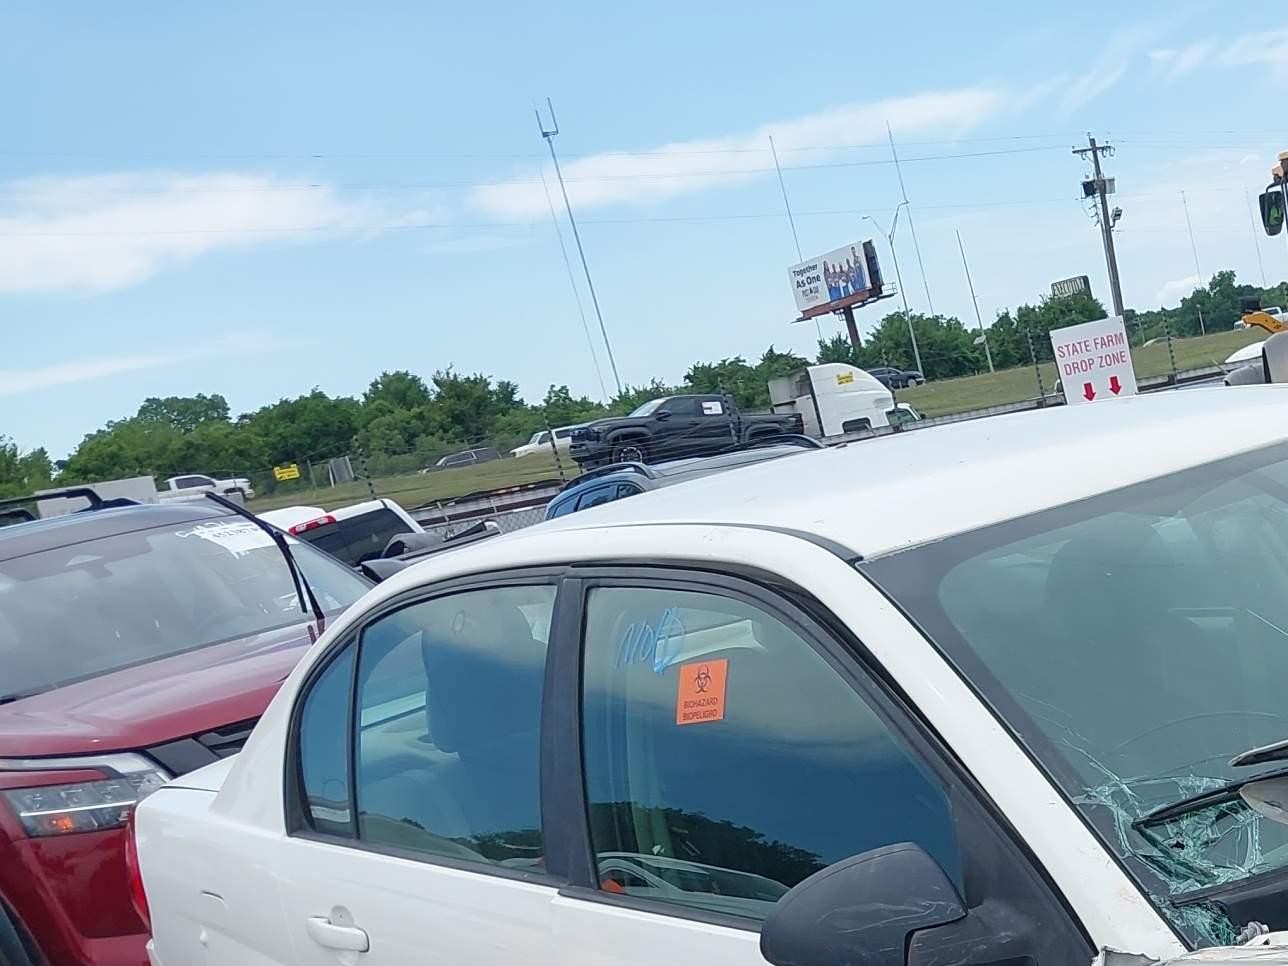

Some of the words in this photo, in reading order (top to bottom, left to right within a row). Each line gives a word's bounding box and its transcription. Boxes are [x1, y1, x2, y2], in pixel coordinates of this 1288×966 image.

[793, 264, 818, 278] Together
[796, 280, 806, 289] As
[806, 274, 821, 286] One
[1057, 340, 1092, 358] STATE
[1094, 332, 1125, 350] FARM
[1064, 358, 1095, 376] DROP
[1097, 351, 1127, 368] ZONE
[684, 697, 718, 709] BIOHAZARD
[683, 709, 718, 721] BIOPELIGRO
